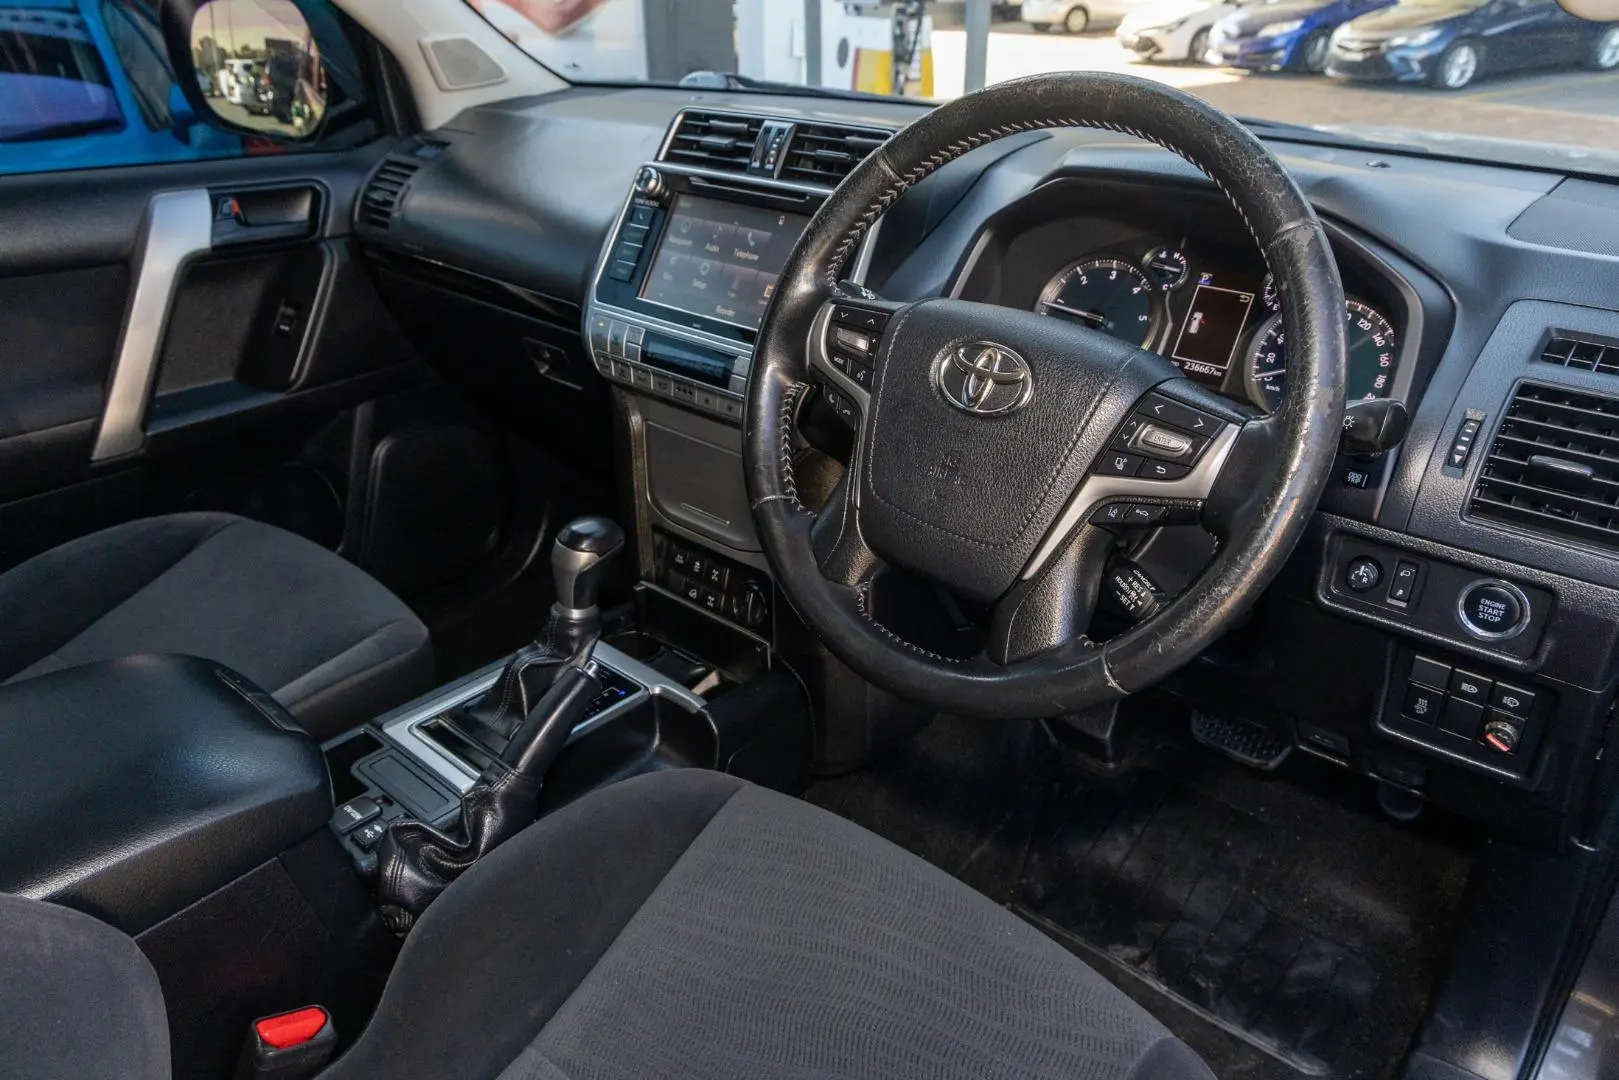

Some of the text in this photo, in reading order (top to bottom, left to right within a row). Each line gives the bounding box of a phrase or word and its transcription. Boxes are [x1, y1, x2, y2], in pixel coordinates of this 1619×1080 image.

[1080, 275, 1088, 286] 2
[1109, 270, 1117, 280] 3
[1132, 286, 1142, 295] 4
[1138, 314, 1148, 322] 5
[1357, 317, 1373, 331] 120
[1372, 332, 1386, 347] 140
[1265, 352, 1276, 364] 20
[1379, 352, 1390, 368] 160
[1373, 374, 1387, 389] 180
[1153, 435, 1172, 446] ENTER
[1132, 581, 1143, 592] RES
[1120, 595, 1131, 605] SET
[1480, 598, 1506, 610] ENGINE
[1478, 605, 1505, 617] START
[1478, 612, 1501, 623] STOP
